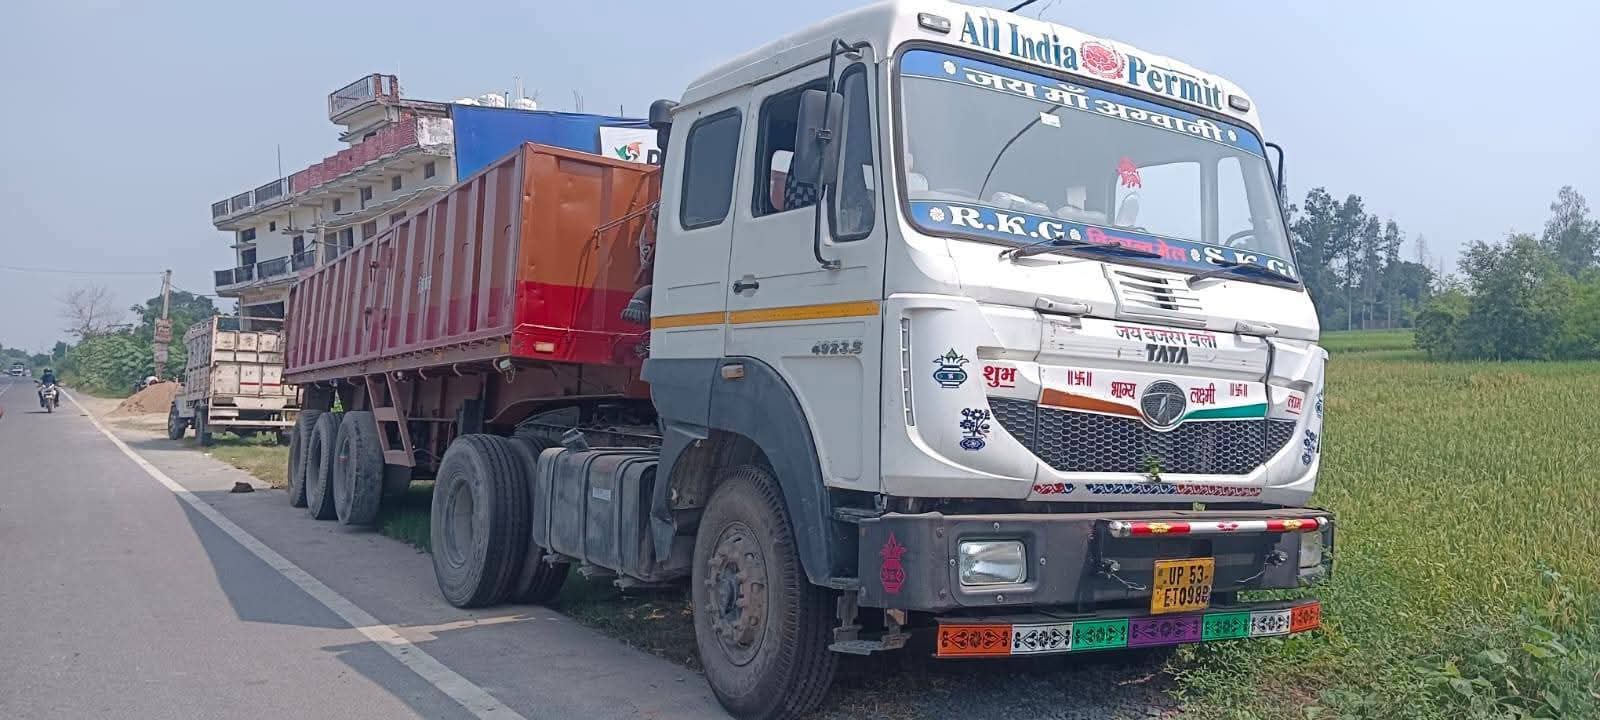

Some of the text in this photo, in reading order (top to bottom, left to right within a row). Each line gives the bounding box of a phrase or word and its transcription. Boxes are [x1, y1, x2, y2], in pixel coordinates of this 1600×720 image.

[960, 12, 1222, 111] All India Permit
[963, 67, 1037, 98] जय
[1041, 83, 1090, 110] माँ
[1113, 325, 1142, 341] जय
[1145, 343, 1189, 364] TATA
[983, 365, 1018, 388] शुभ
[1168, 565, 1204, 585] UP 53
